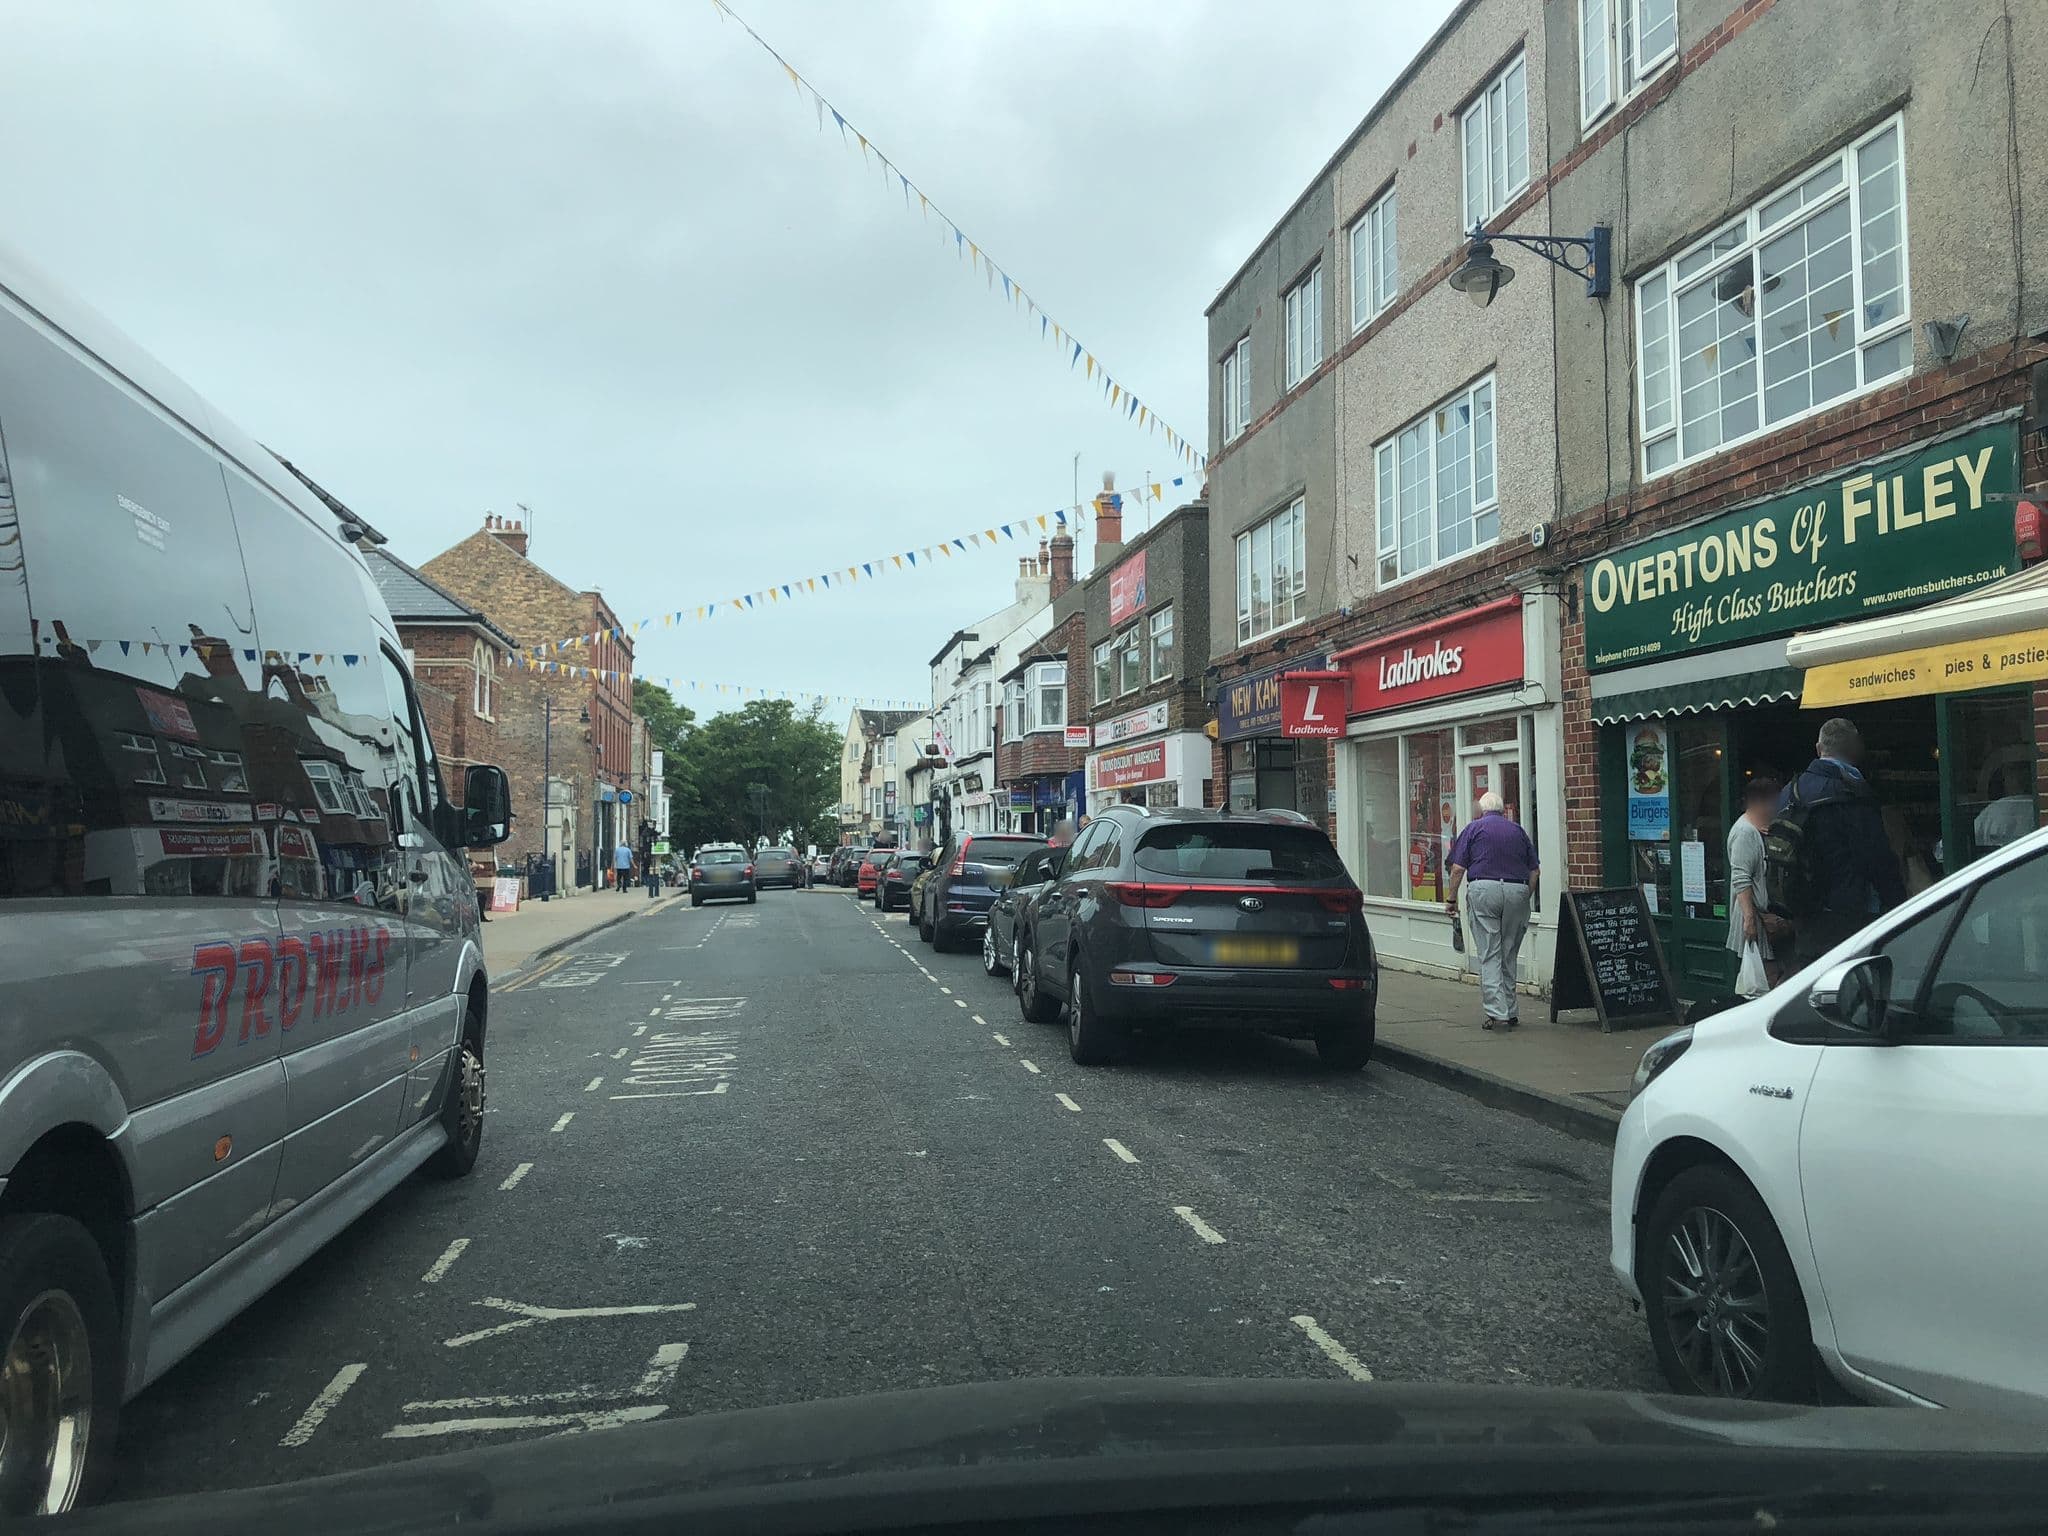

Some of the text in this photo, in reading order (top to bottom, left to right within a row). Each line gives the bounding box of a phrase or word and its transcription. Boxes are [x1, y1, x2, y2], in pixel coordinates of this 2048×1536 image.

[1591, 446, 1994, 613] OVERTONS Of FILEY
[1671, 565, 1857, 643] High Class Butchers
[1862, 565, 2007, 607] www.overtonsbutchers.co.uk
[1379, 639, 1462, 691] Ladbrokes
[1594, 649, 1622, 665] Telephone
[1622, 645, 1640, 659] 01723
[1849, 667, 1916, 689] sandwiches
[1945, 658, 1974, 678] pies
[1982, 653, 1991, 670] &
[1232, 684, 1252, 718] NEW
[1303, 685, 1325, 721] L
[1289, 724, 1339, 735] Ladbrokes
[1631, 804, 1669, 822] Burgers
[190, 925, 390, 1061] BROWNS
[609, 996, 749, 1100] LOADING ONLY
